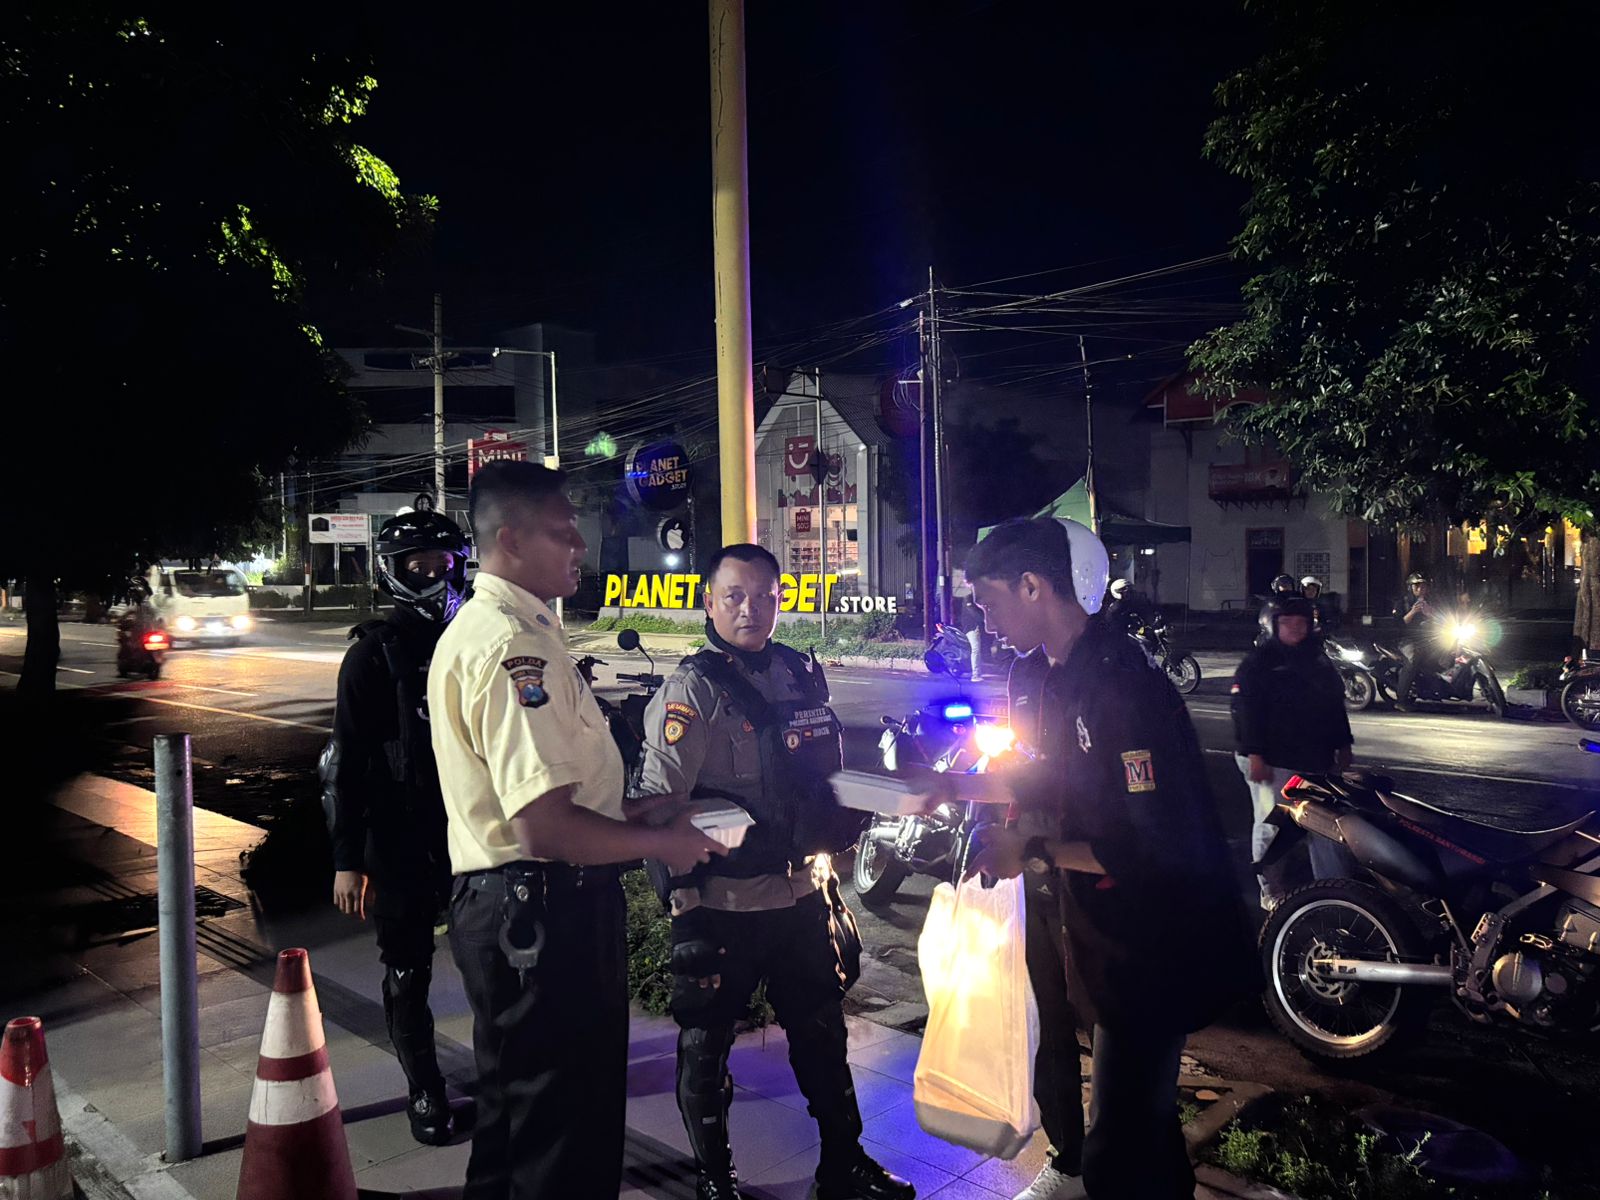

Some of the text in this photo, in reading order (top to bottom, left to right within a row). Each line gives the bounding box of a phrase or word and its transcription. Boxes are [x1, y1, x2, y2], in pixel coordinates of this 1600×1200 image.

[638, 468, 689, 488] GADGET
[604, 573, 701, 609] PLANET
[506, 657, 544, 669] POLDA
[1126, 760, 1152, 783] M
